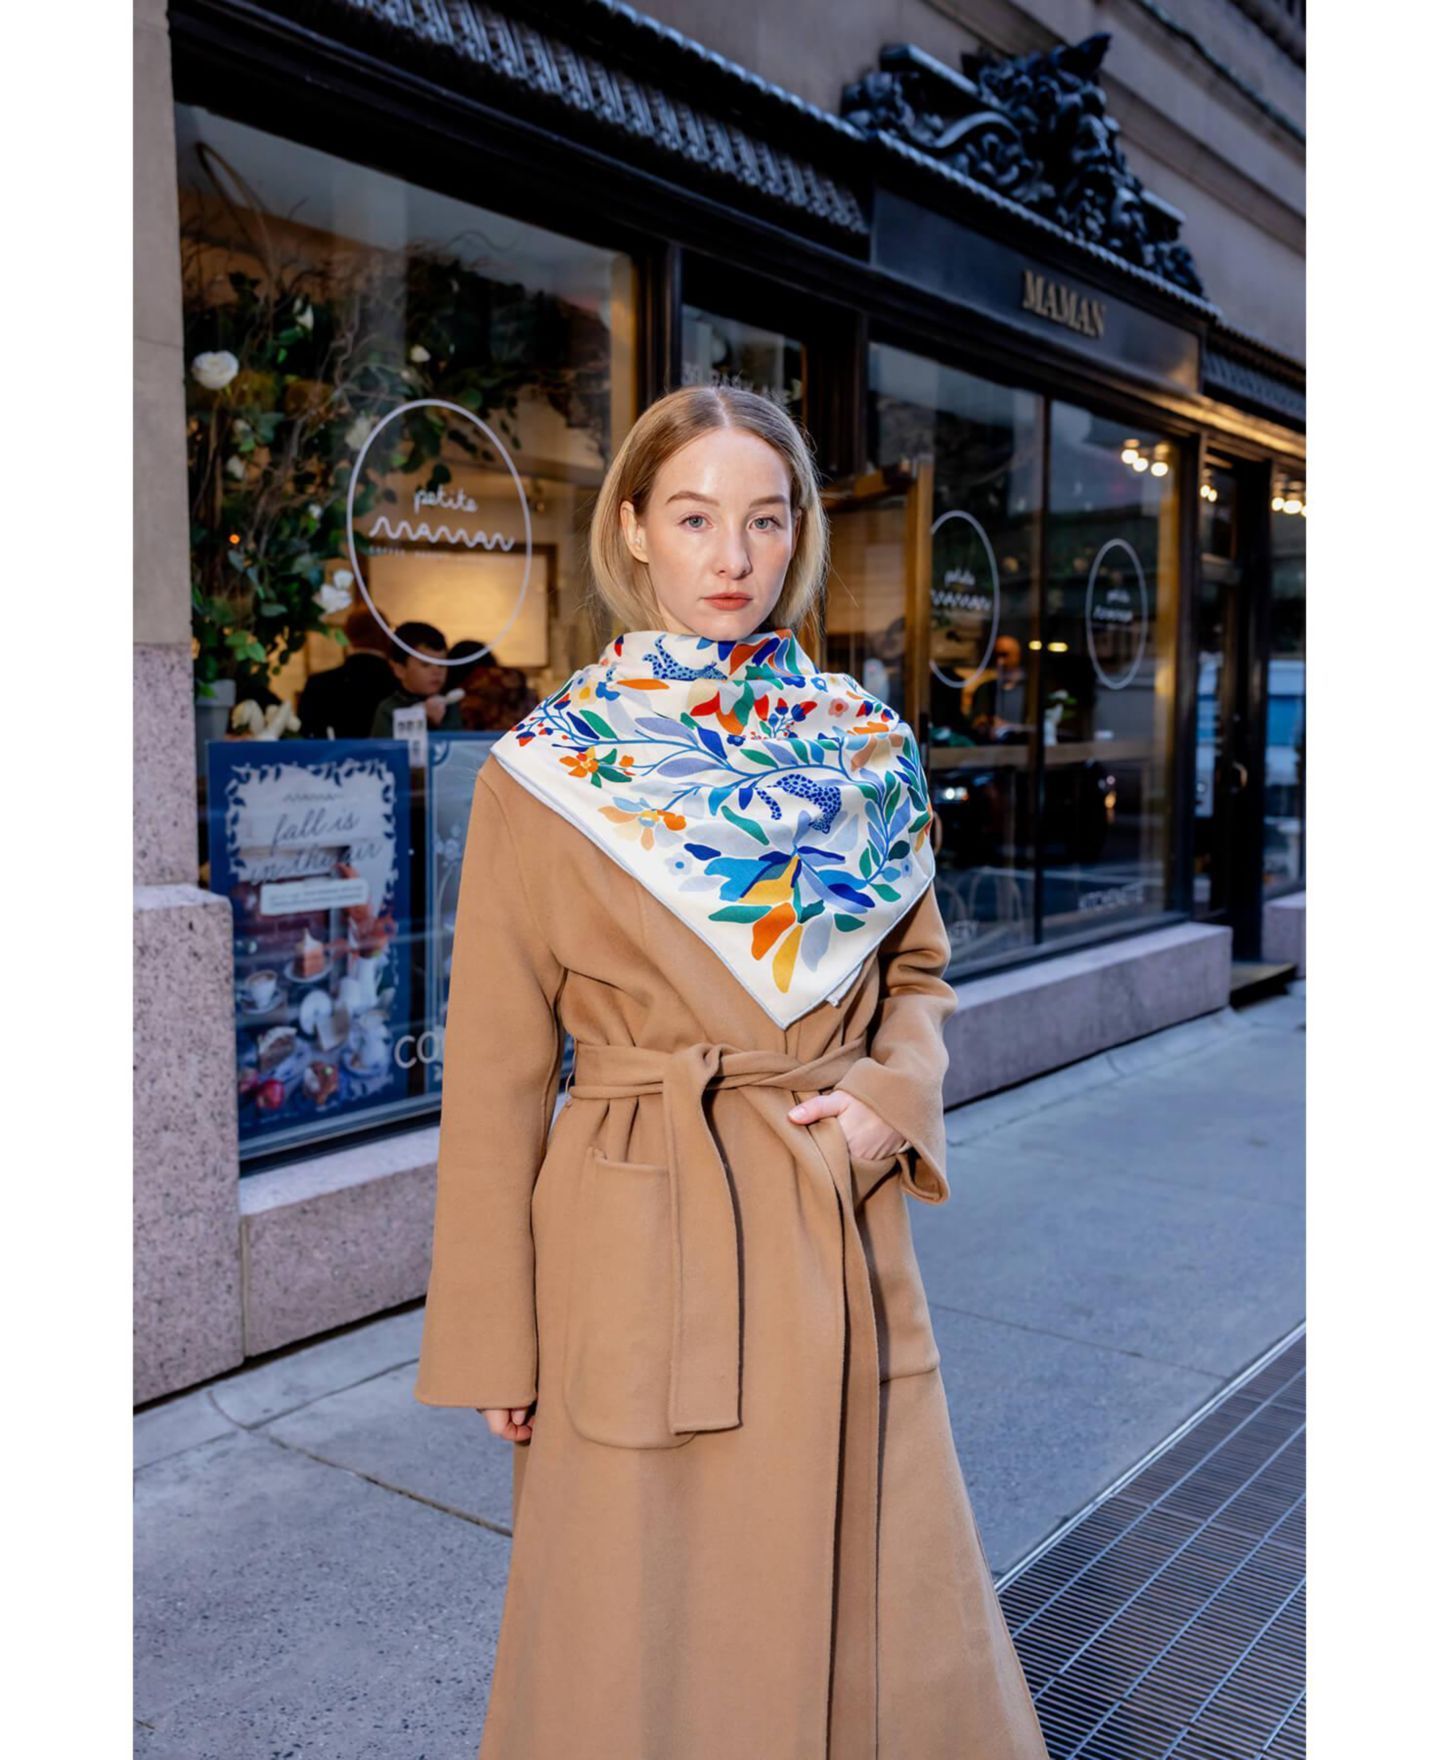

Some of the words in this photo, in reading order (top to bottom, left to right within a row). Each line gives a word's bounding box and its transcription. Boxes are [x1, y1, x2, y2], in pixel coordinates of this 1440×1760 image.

[1022, 269, 1106, 338] MAMAN
[414, 485, 479, 514] petite
[368, 516, 515, 552] maman
[271, 808, 327, 857] fall
[331, 809, 359, 832] is
